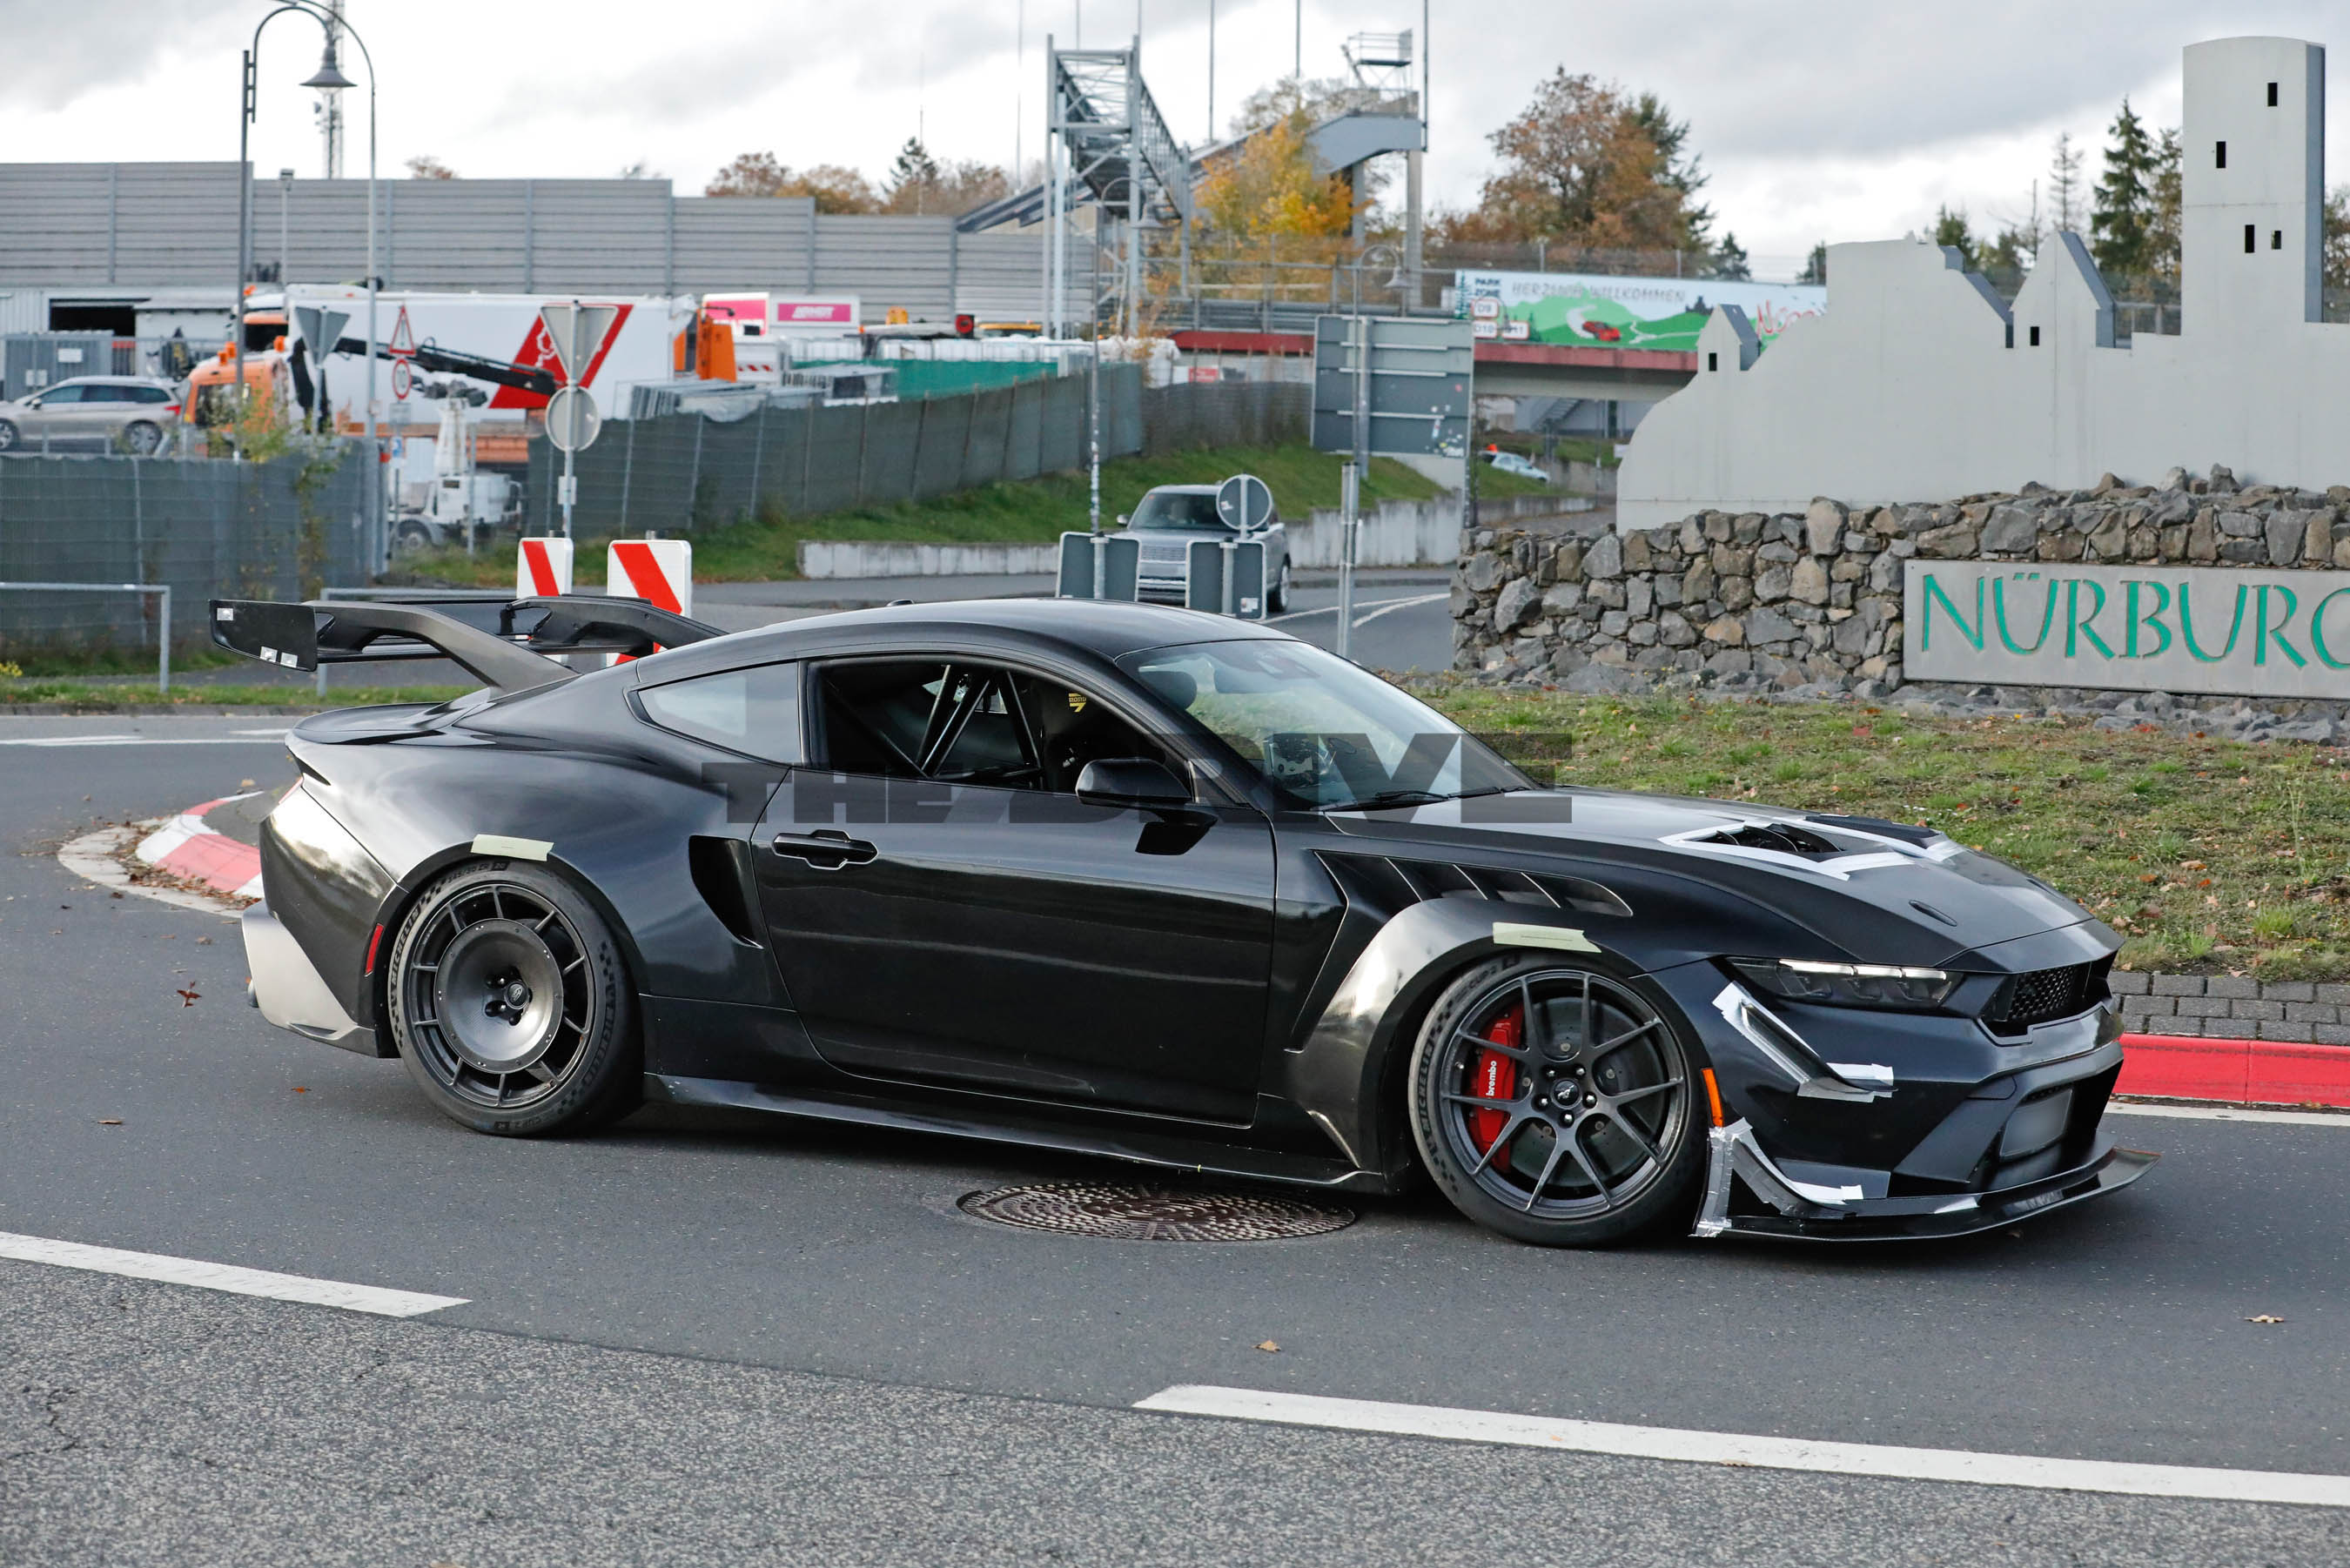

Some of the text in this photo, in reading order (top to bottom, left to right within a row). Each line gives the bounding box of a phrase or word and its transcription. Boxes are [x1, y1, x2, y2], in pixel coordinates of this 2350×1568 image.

[391, 908, 419, 986] MICHELIN
[1418, 1045, 1434, 1133] MICHELIN
[1485, 1060, 1497, 1096] brembo
